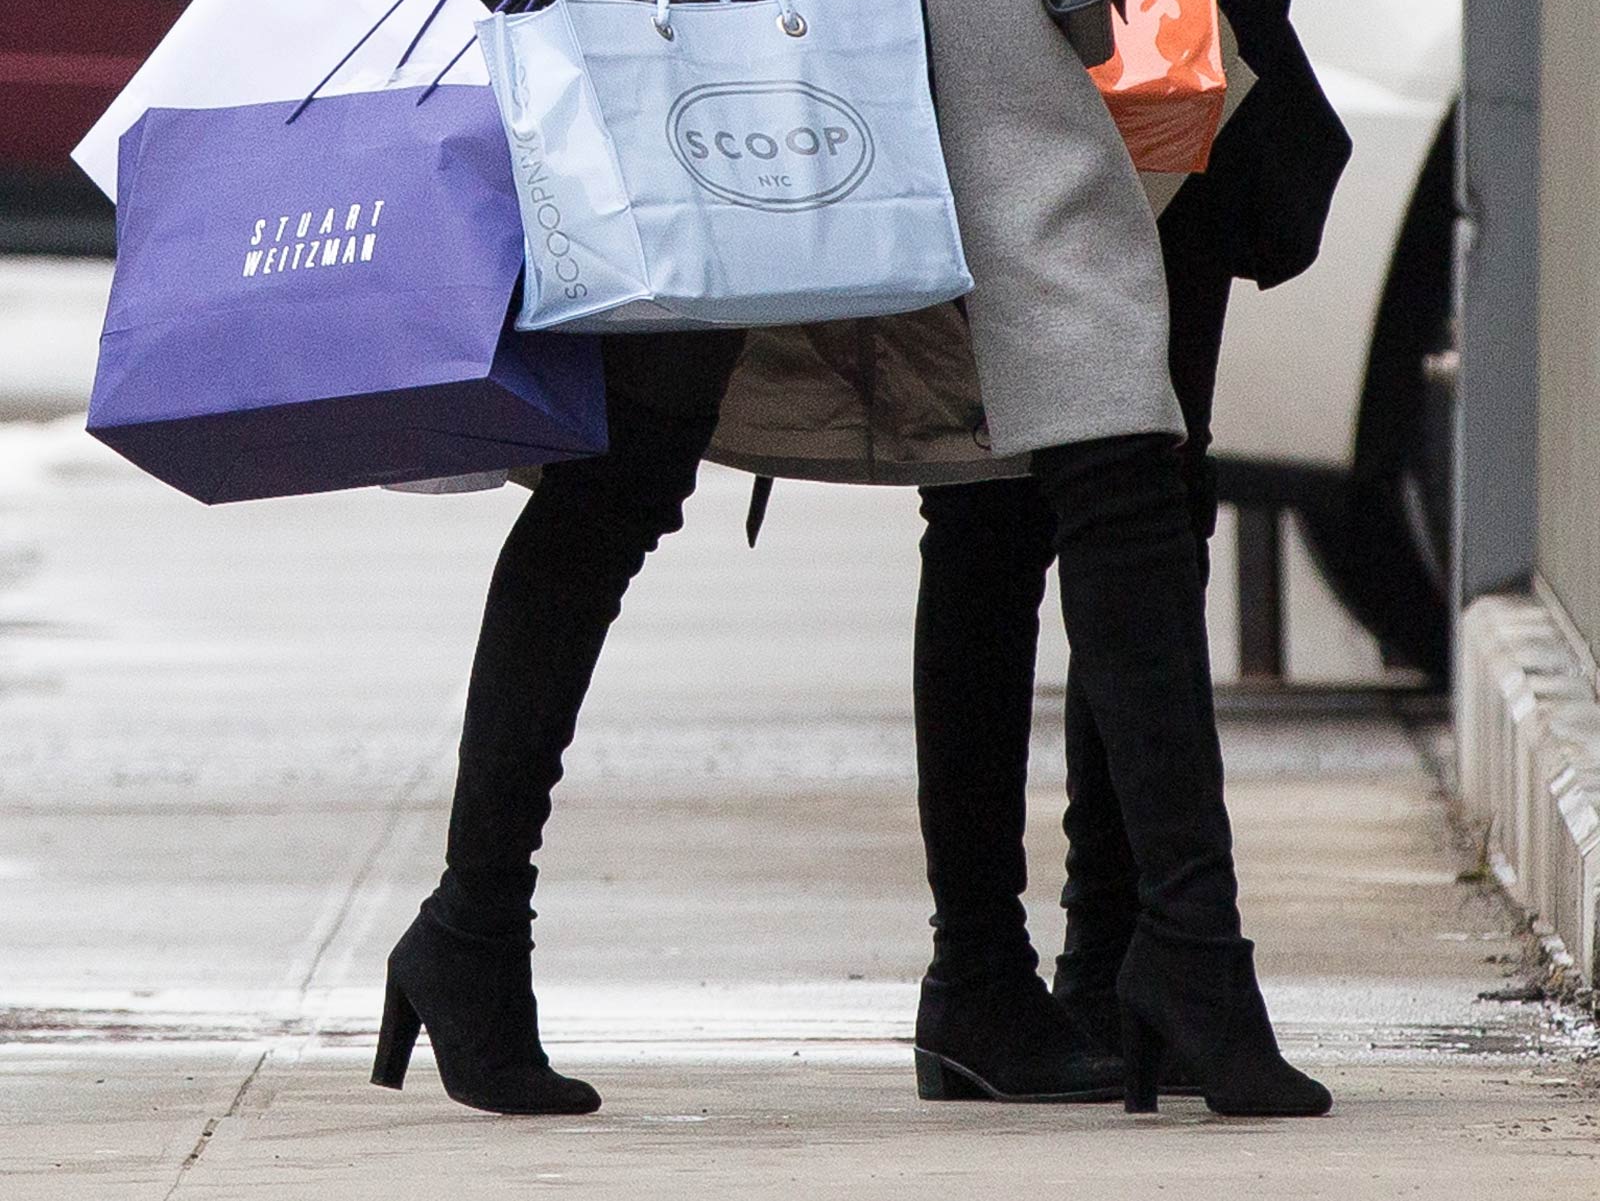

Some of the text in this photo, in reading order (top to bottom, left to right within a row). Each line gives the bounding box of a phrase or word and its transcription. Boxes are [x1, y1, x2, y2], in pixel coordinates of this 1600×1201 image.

[685, 125, 849, 160] SCOOP
[757, 174, 792, 188] NYC
[251, 200, 385, 246] STUART
[242, 233, 377, 278] WEITZMAN
